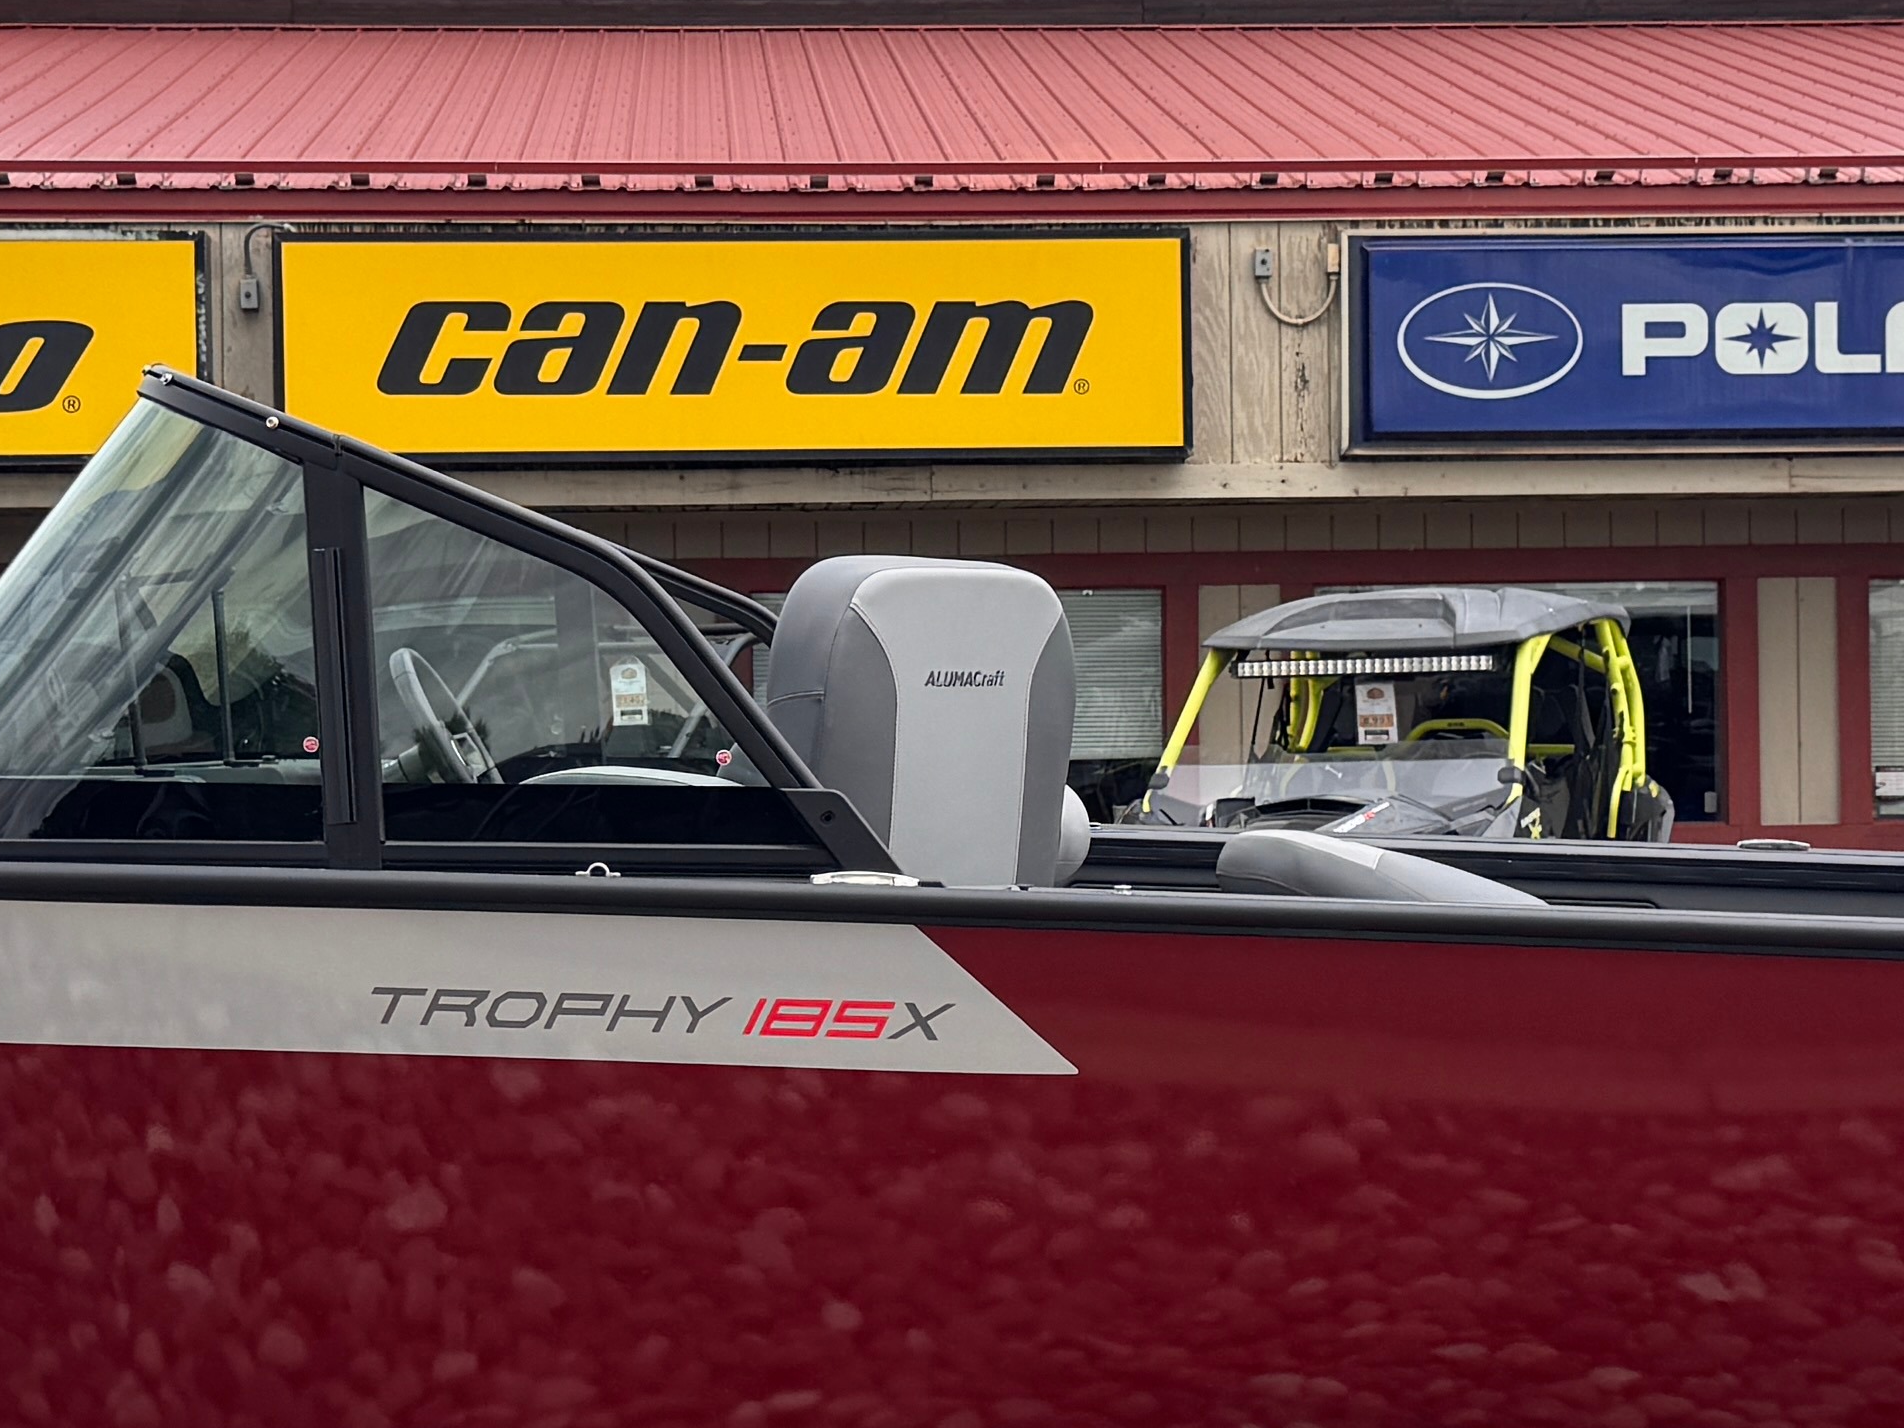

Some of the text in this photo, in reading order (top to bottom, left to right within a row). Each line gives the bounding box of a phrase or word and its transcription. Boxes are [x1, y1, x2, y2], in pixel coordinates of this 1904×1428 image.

[375, 299, 1095, 397] can-am
[924, 669, 1005, 687] ALUMACraft
[370, 986, 957, 1041] TROPHY 185X
